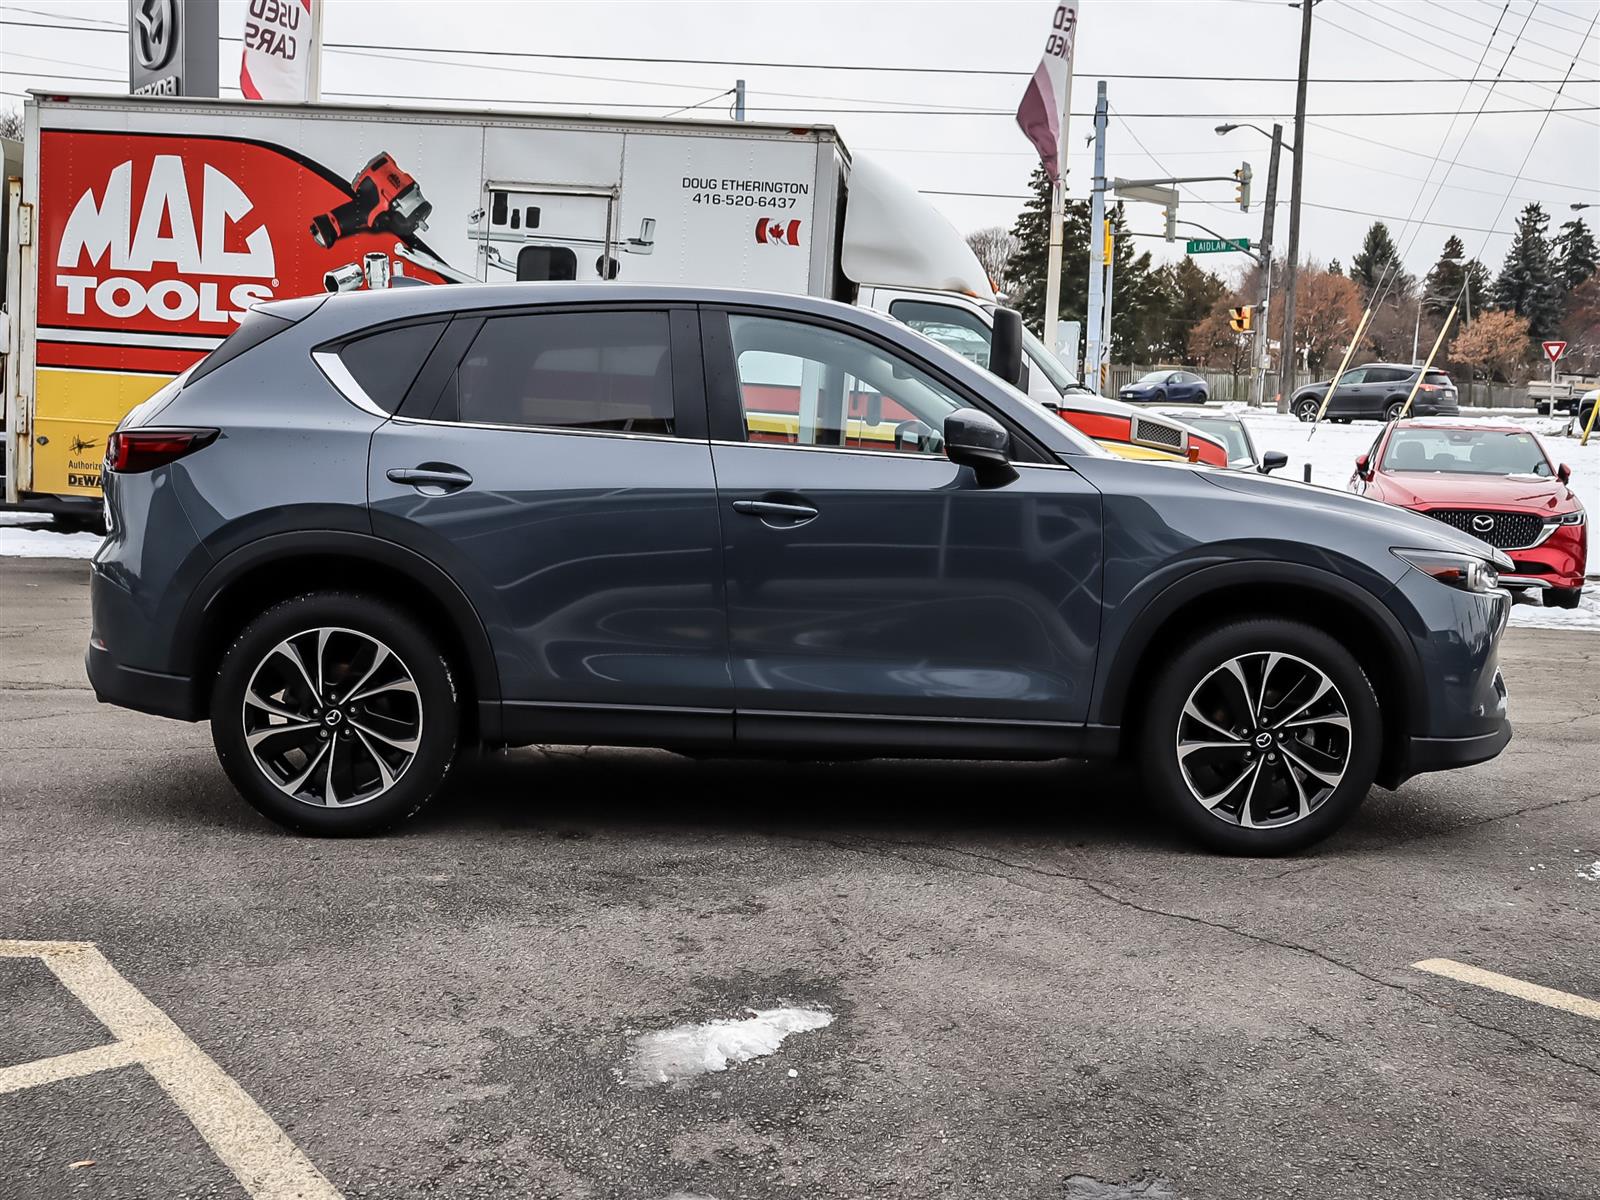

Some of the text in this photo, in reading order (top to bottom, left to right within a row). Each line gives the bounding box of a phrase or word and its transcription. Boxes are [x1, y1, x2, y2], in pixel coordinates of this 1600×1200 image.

[682, 177, 808, 195] DOUG ETHERINGTON
[692, 192, 797, 209] 416-520-6437
[57, 154, 276, 278] MAC
[1193, 240, 1227, 252] LAIDLAW
[56, 274, 274, 324] TOOLS
